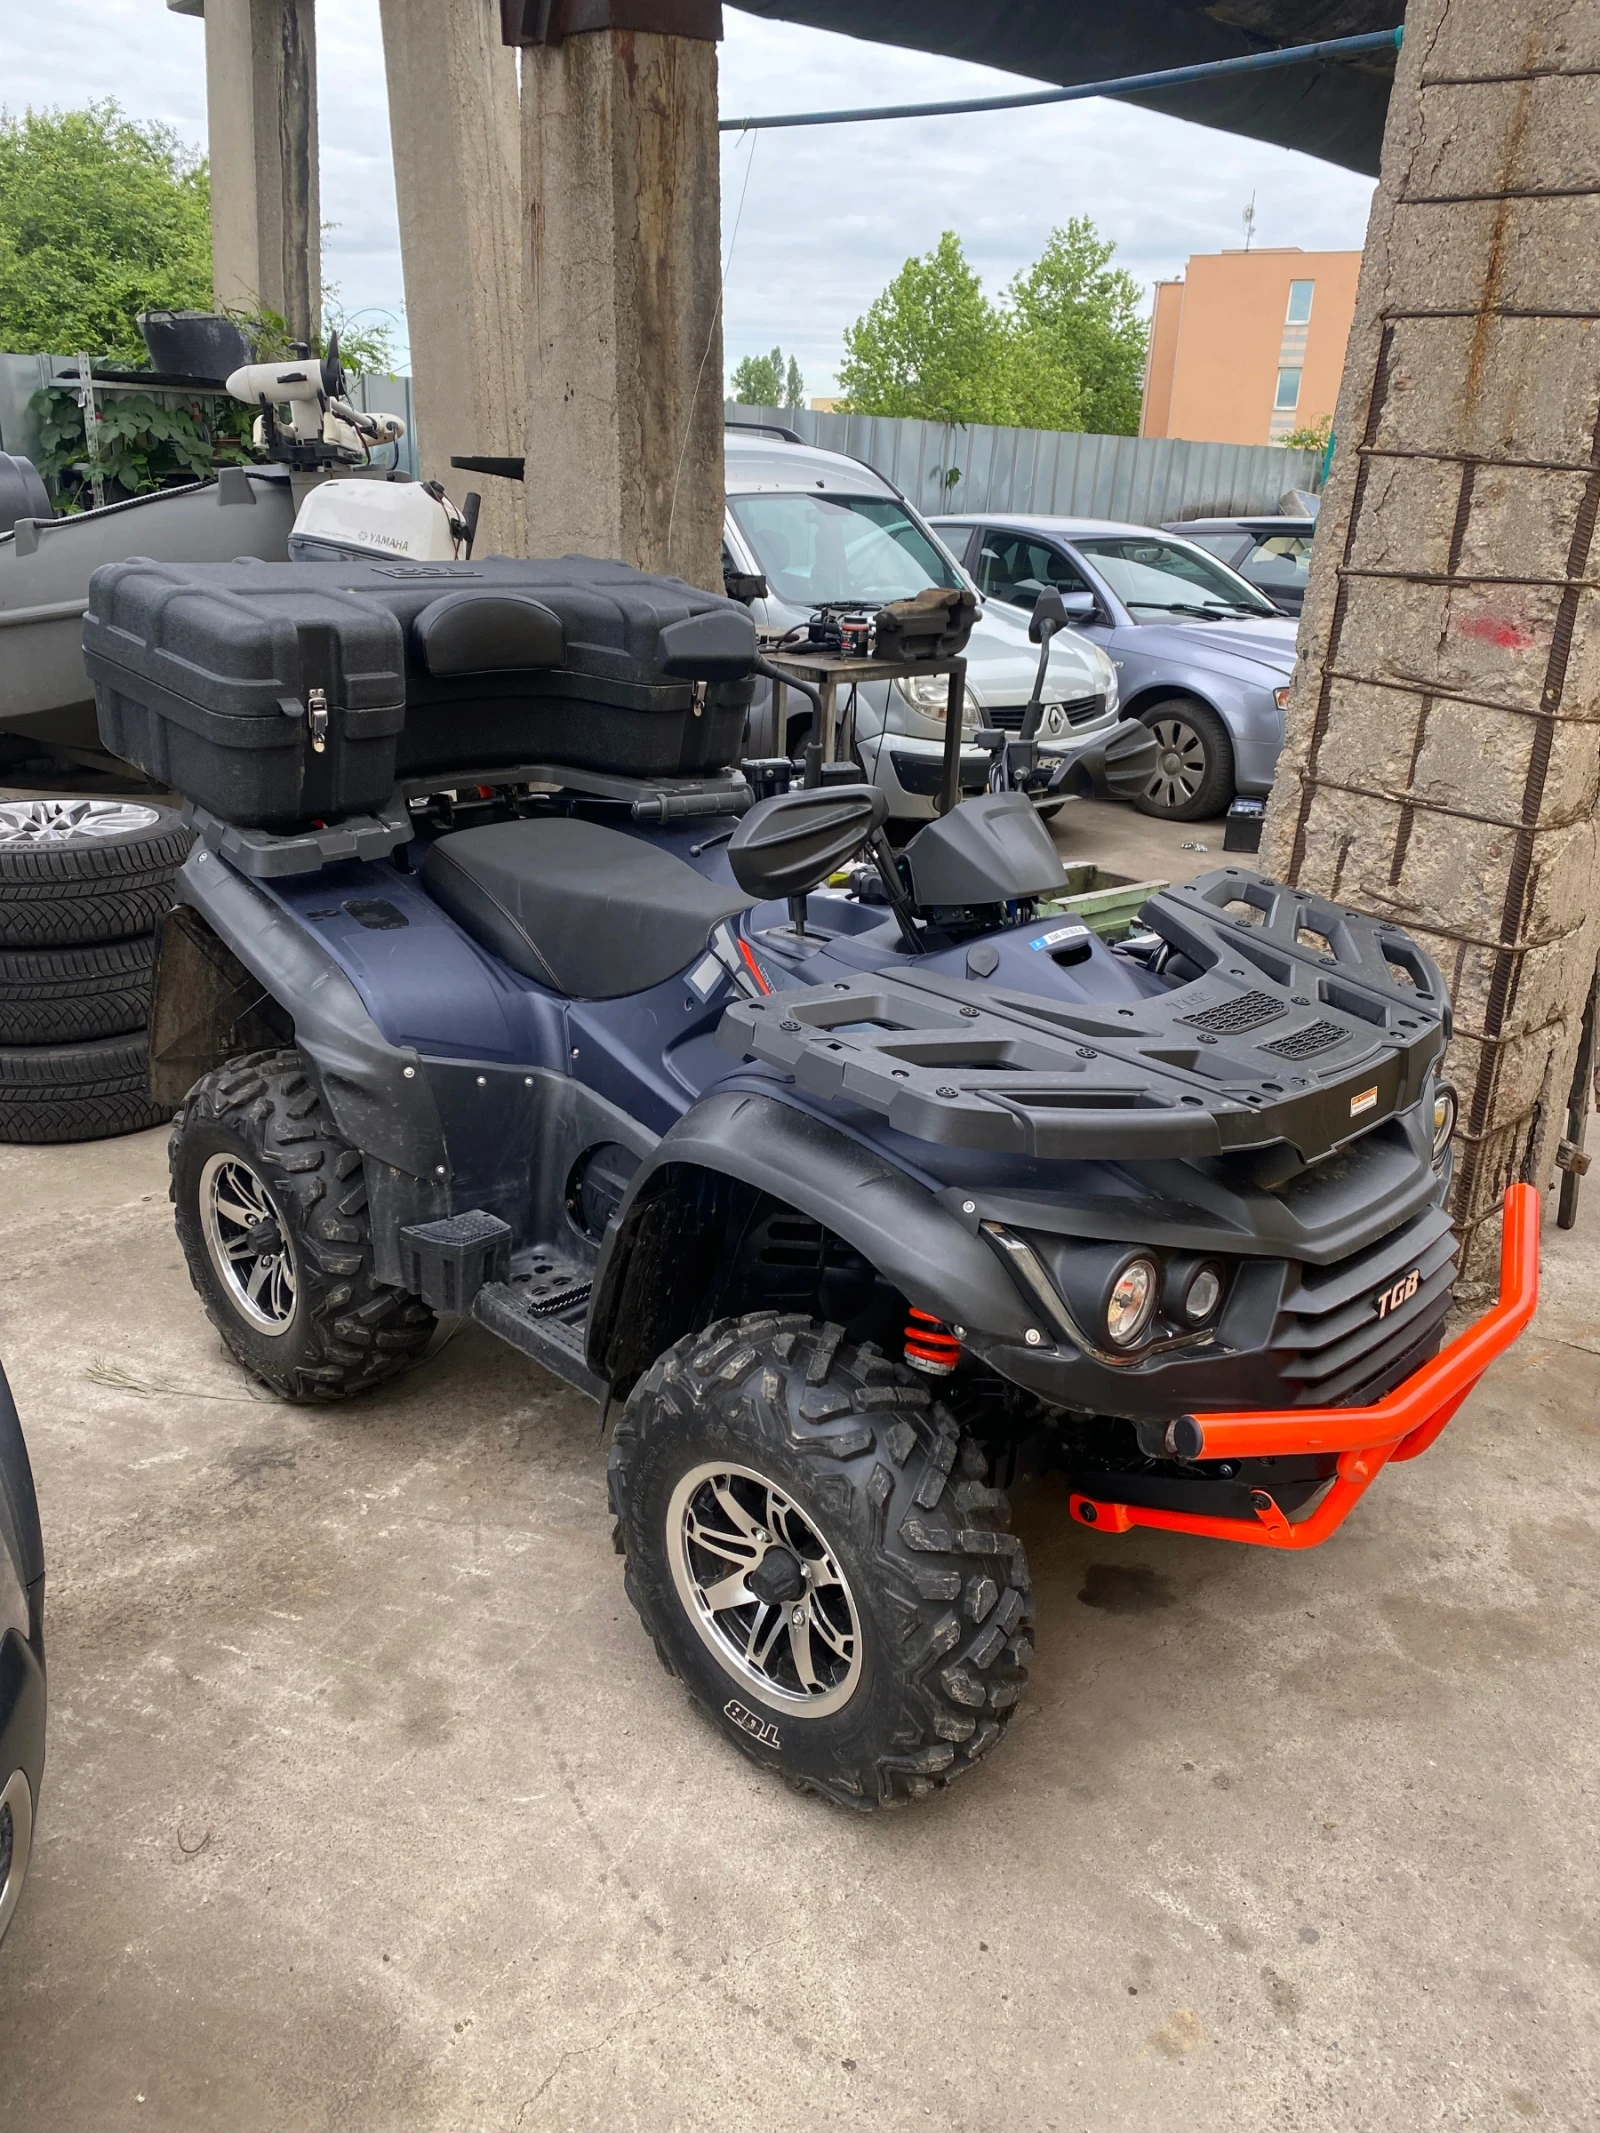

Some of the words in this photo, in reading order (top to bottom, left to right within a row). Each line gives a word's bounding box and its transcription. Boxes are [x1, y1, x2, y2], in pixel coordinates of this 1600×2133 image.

[370, 532, 409, 552] YAMAHA
[1378, 1268, 1420, 1320] TGB
[723, 1699, 782, 1751] TGB
